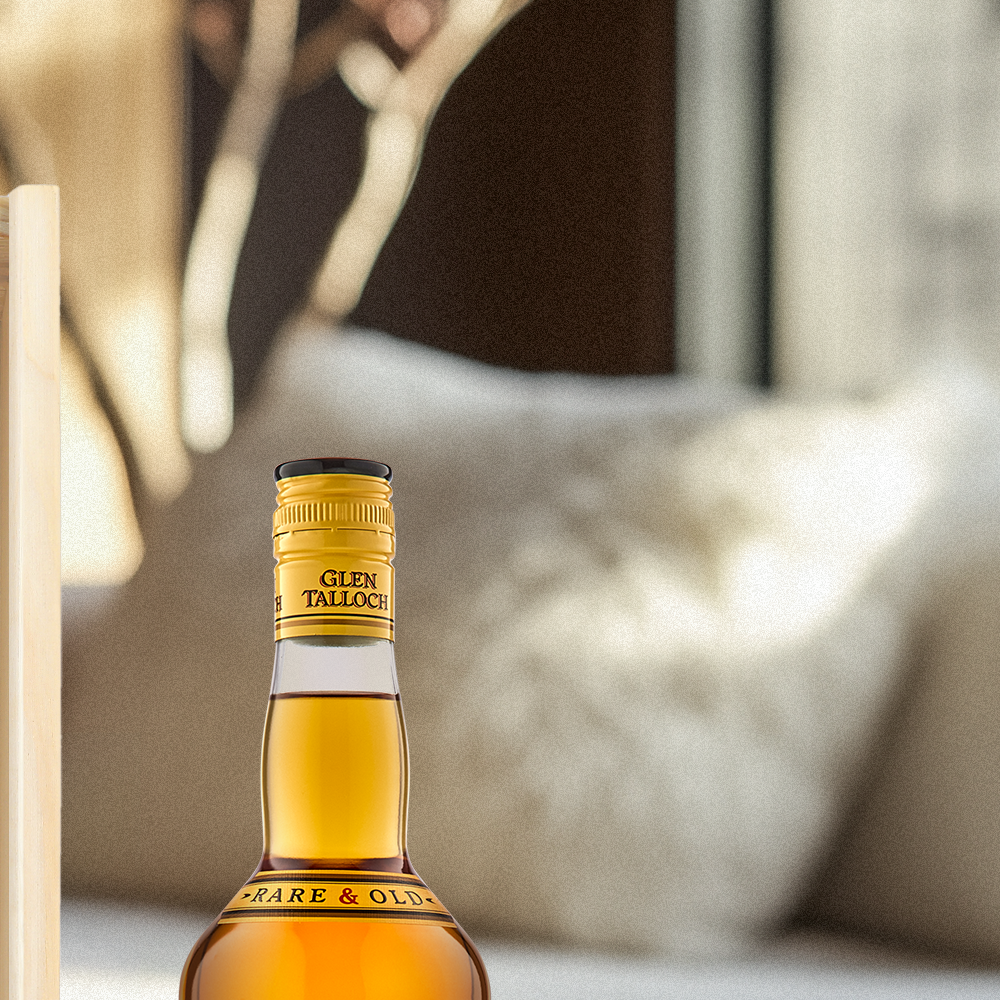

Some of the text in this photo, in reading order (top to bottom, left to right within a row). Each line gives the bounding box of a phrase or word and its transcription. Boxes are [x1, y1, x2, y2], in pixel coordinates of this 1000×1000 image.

[319, 569, 377, 590] GLEN
[301, 589, 389, 612] TALLOCH
[250, 887, 425, 906] RARE & OLD
